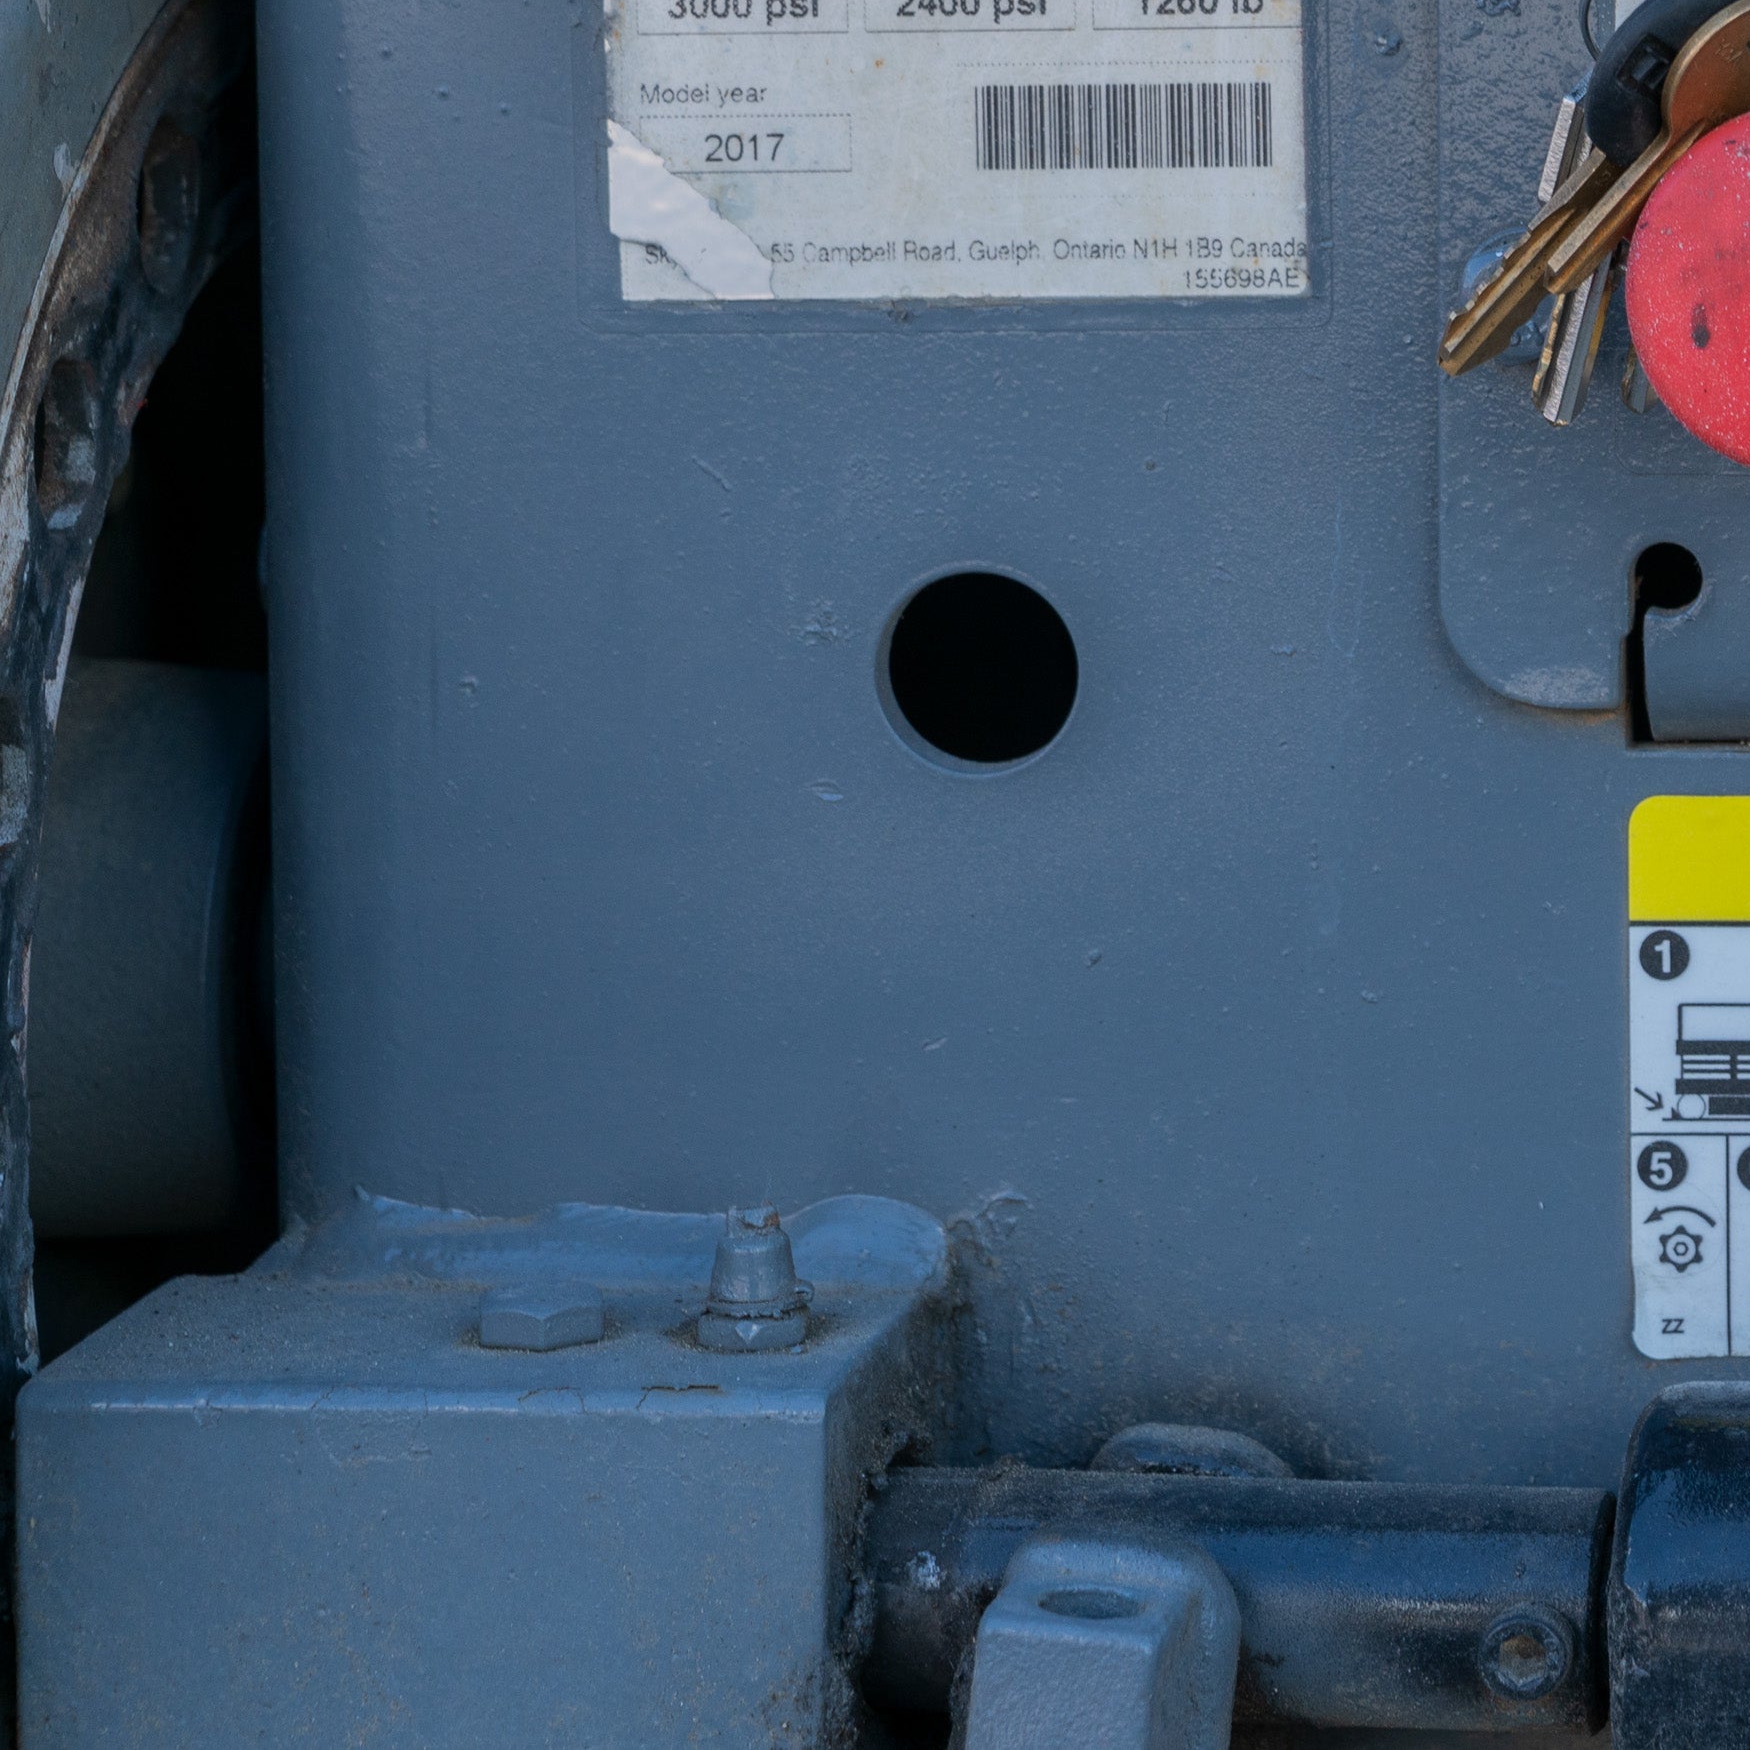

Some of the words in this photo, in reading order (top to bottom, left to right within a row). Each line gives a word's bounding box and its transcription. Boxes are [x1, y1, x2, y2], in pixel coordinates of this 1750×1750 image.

[640, 83, 710, 105] Model
[716, 86, 767, 108] year
[704, 132, 784, 163] 2017
[803, 240, 896, 266] Campbell
[1053, 238, 1126, 260] Ontario
[1133, 237, 1178, 260] N1H
[1230, 236, 1307, 258] Canada
